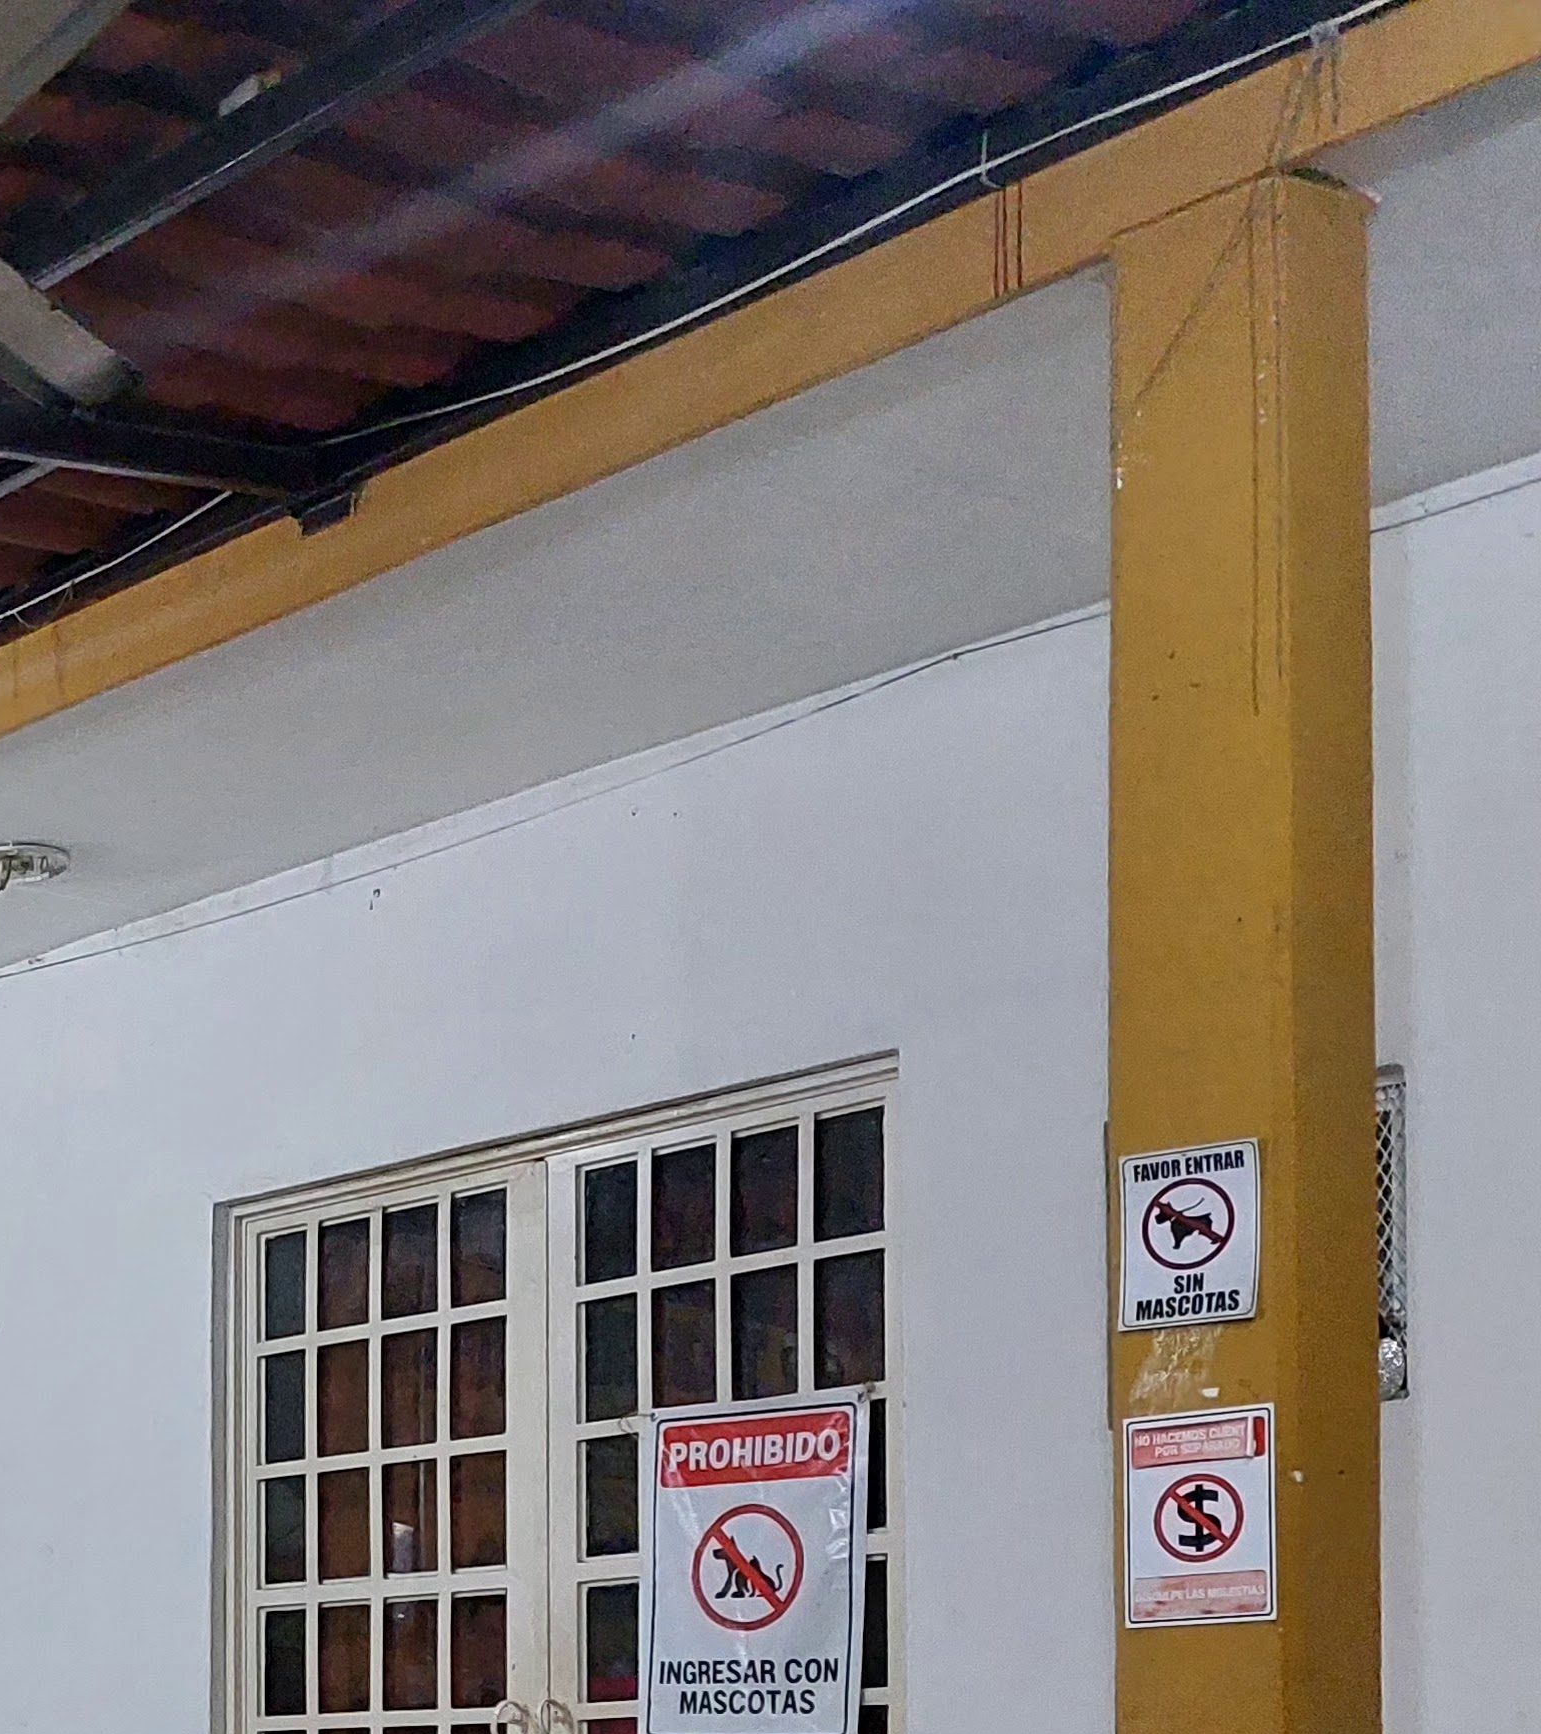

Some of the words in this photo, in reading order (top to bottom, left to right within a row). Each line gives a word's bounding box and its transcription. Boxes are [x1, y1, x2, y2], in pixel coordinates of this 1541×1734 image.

[1133, 1158, 1182, 1183] FAVOR
[1185, 1149, 1245, 1176] ENTRAR
[1173, 1272, 1205, 1295] SIN
[1135, 1289, 1241, 1322] MASCOTAS
[667, 1427, 842, 1472] PROHIBIDO
[659, 1658, 777, 1686] INGRESAR
[784, 1657, 840, 1683] CON
[679, 1688, 817, 1715] MASCOTAS
